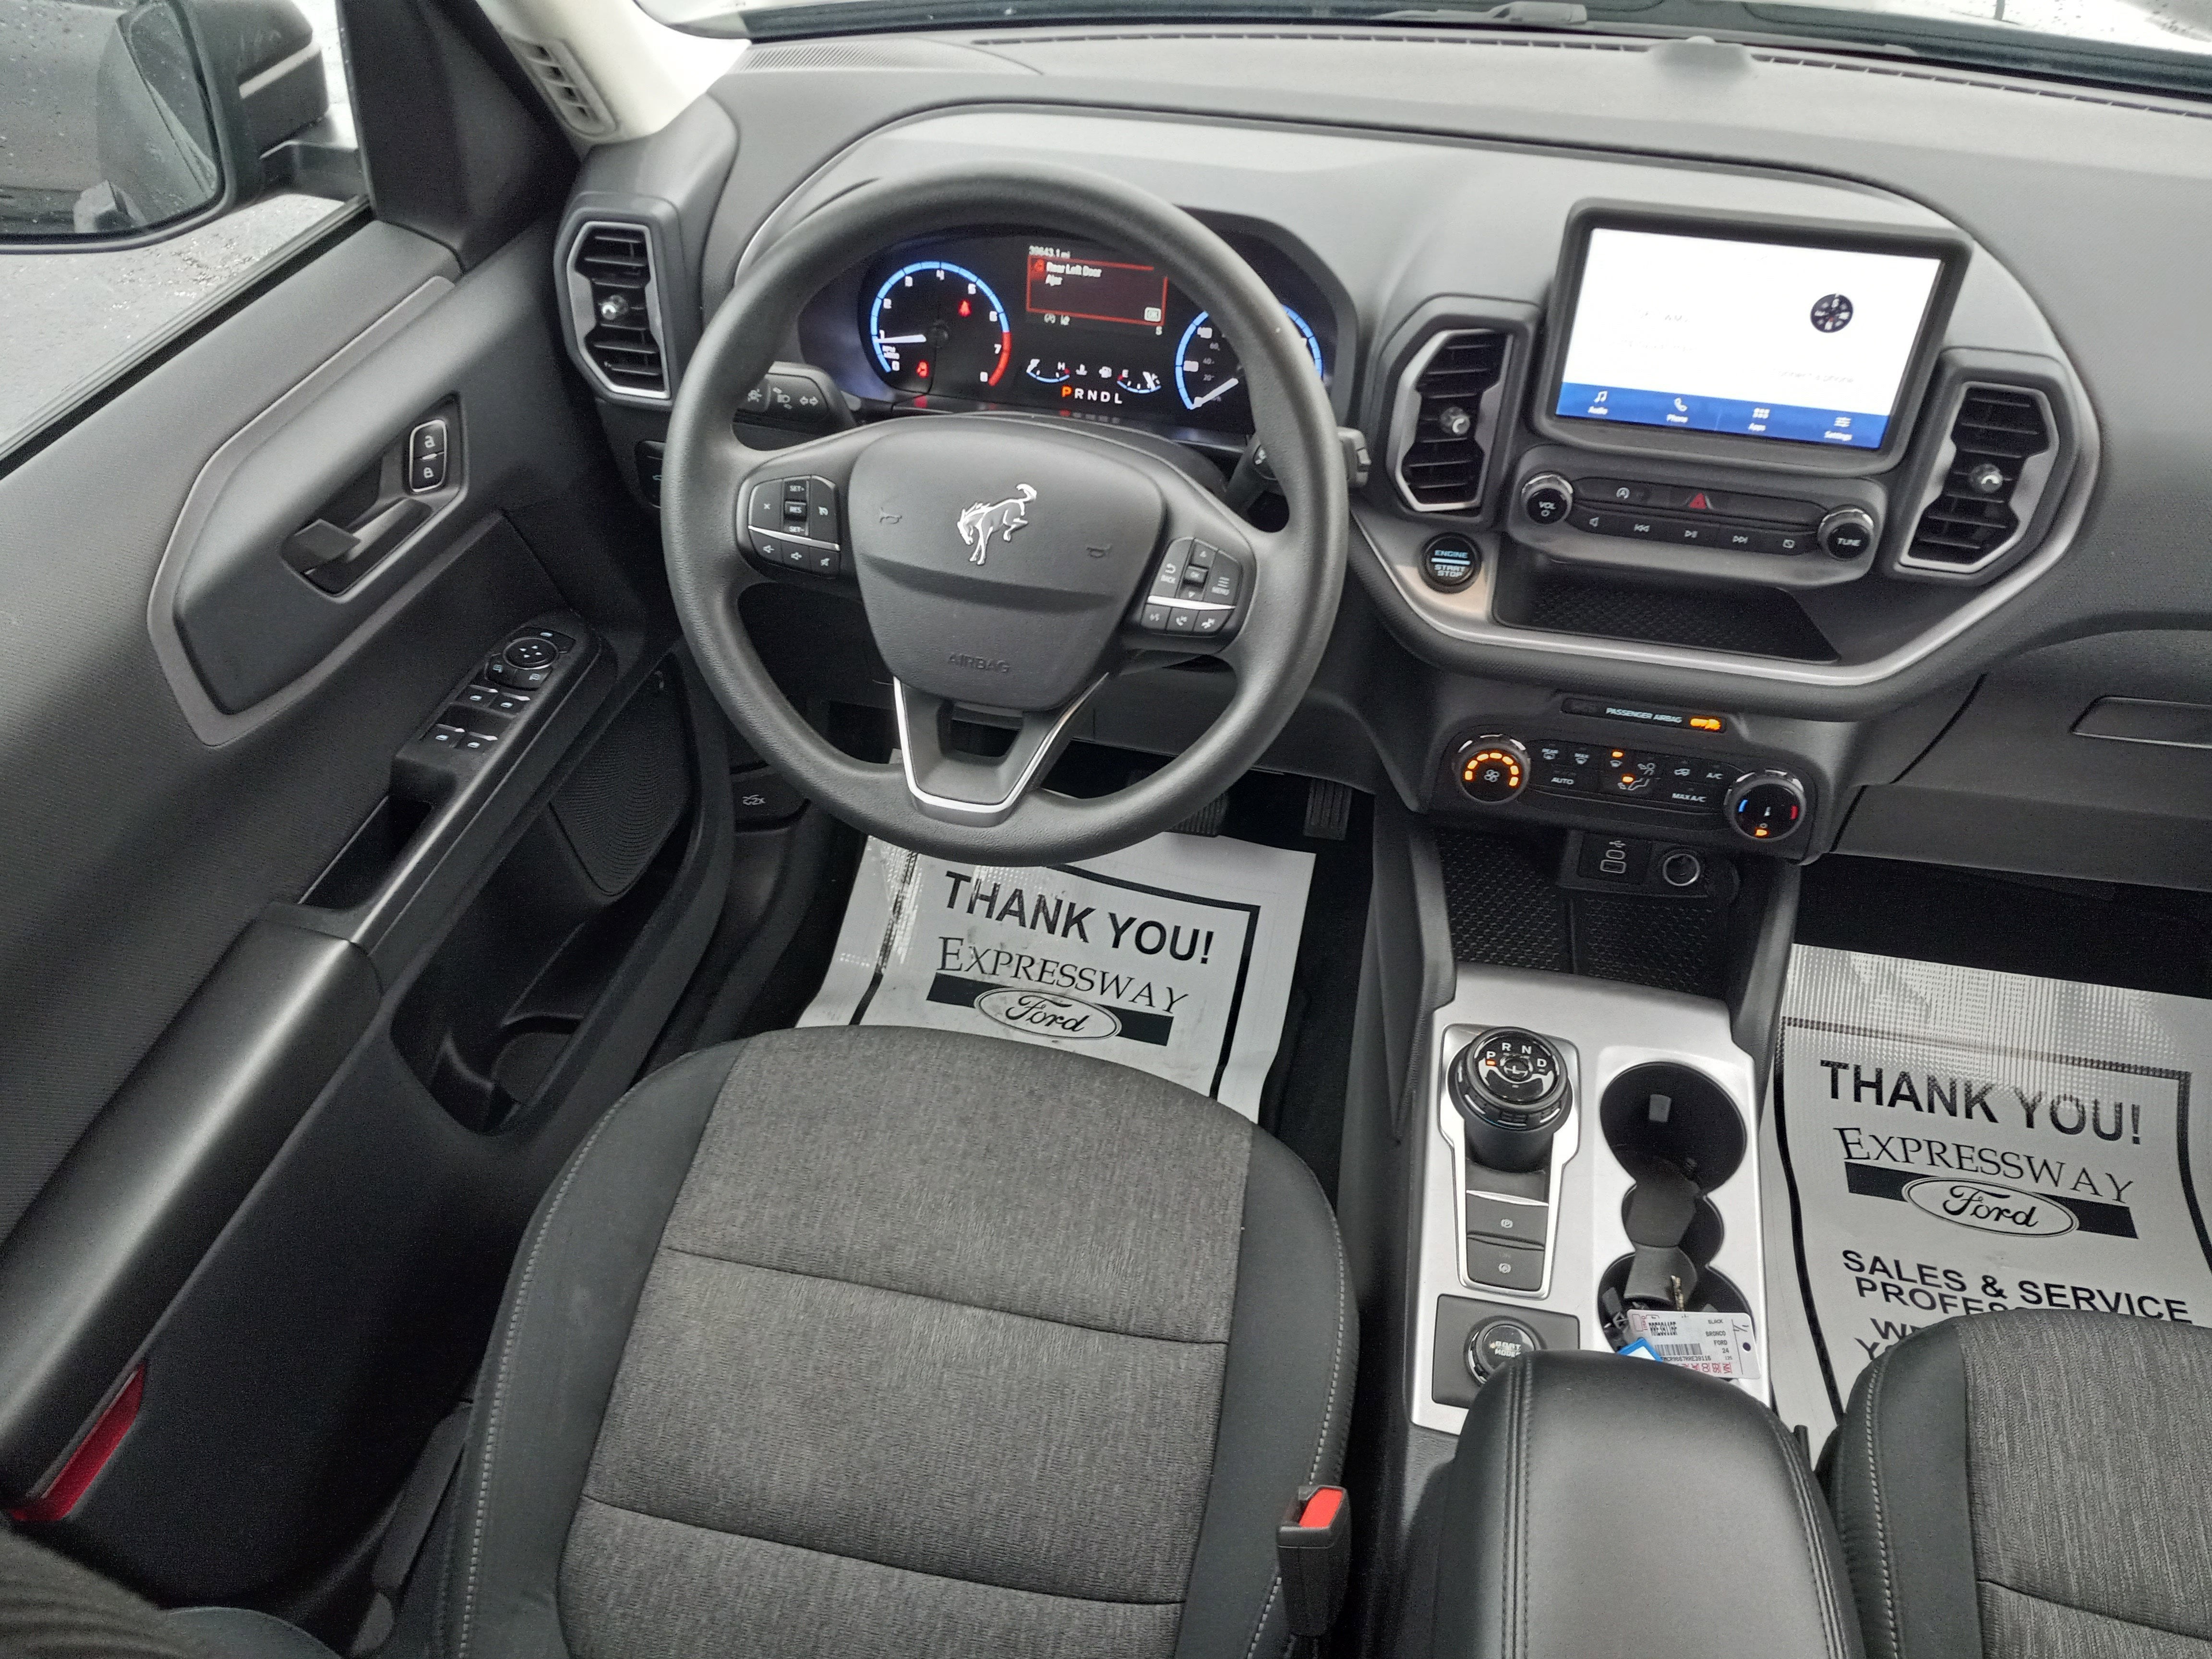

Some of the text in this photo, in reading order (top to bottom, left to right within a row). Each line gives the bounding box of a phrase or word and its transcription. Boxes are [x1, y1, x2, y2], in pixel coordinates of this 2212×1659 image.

[994, 344, 1001, 354] 7
[1058, 361, 1065, 370] H
[1539, 501, 1556, 509] VOL
[1434, 550, 1468, 558] ENGINE
[1837, 538, 1862, 546] TUNE
[1606, 707, 1683, 723] PASSENGER AIRBAG
[945, 870, 1214, 964] THANK YOU!
[936, 936, 1189, 1014] EXPRESSWAY
[1006, 994, 1090, 1033] Ford
[1486, 1042, 1547, 1068] P R N D
[1820, 1059, 2141, 1145] THANK YOU!
[1833, 1127, 2134, 1204] EXPRESSWAY
[1943, 1184, 2039, 1228] Ford
[1842, 1249, 2193, 1325] SALES & SERVICE
